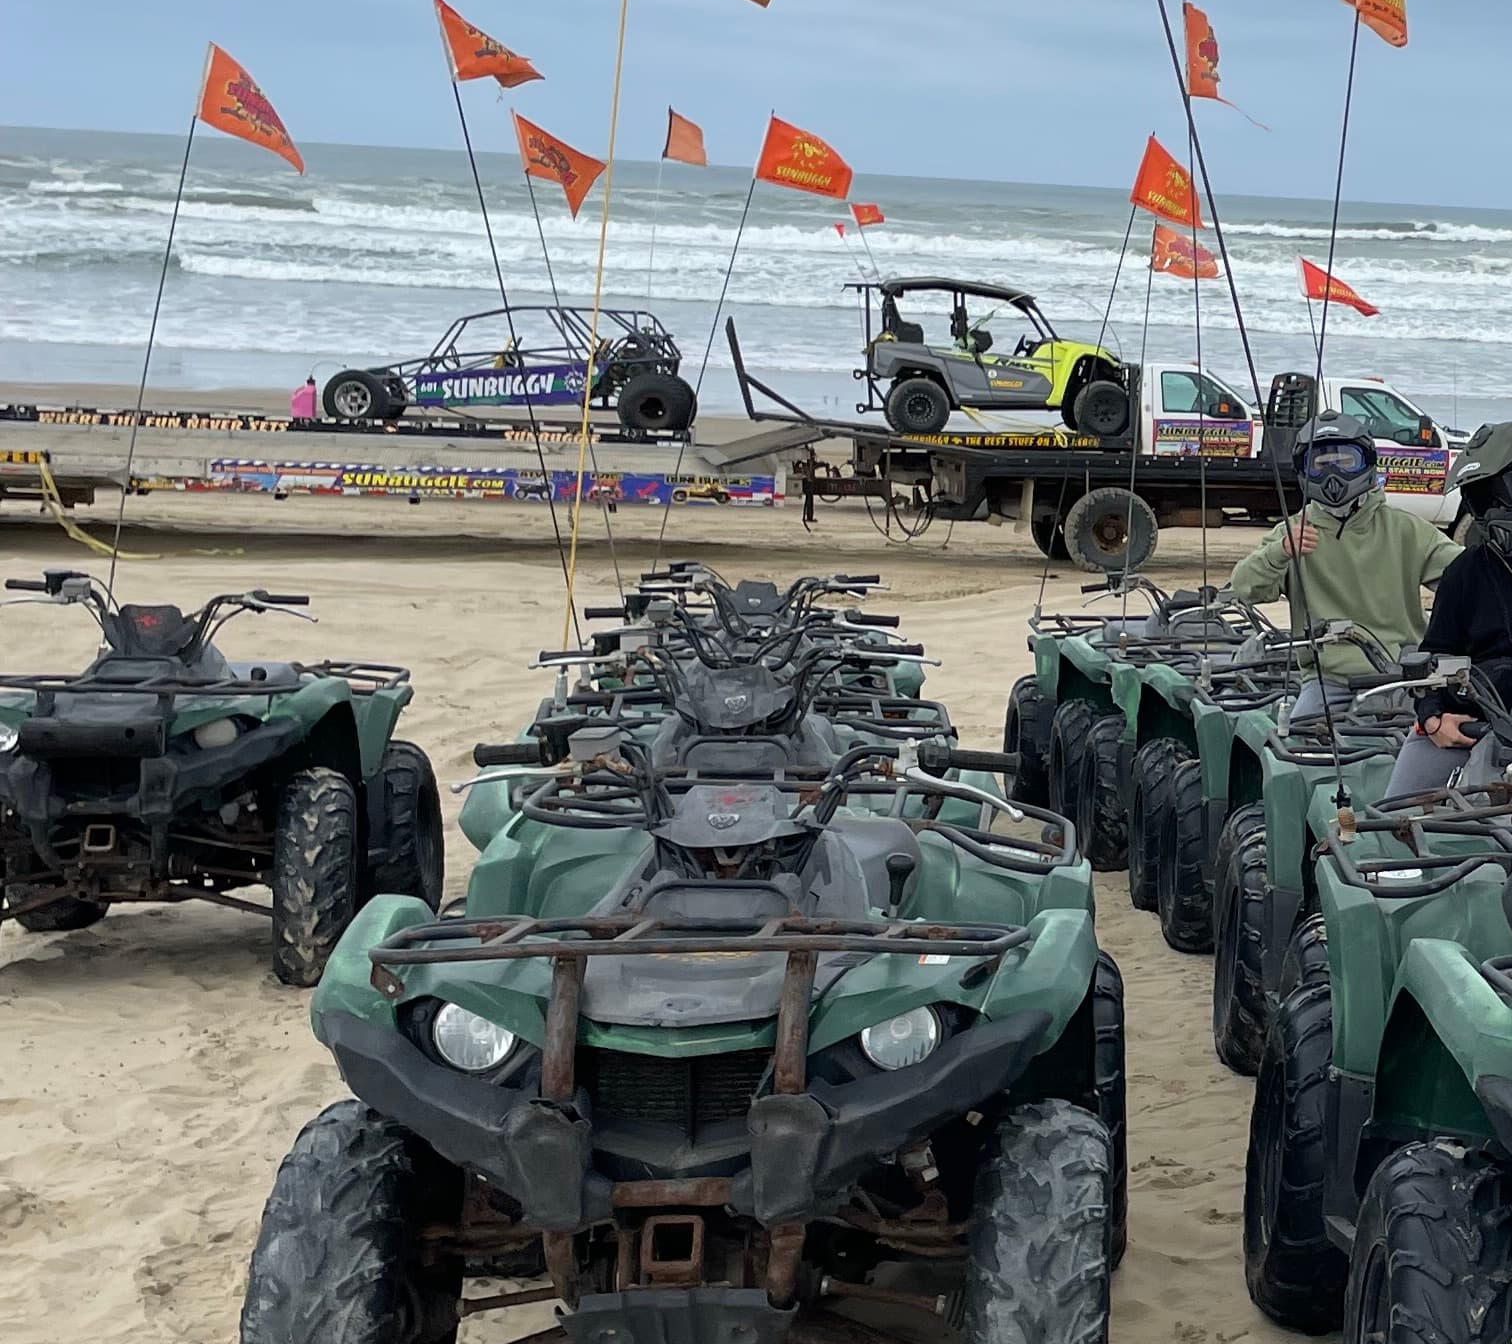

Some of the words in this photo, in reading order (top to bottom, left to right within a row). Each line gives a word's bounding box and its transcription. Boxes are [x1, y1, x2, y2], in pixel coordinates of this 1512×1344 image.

[441, 372, 556, 400] SUNBUGGY
[38, 411, 101, 425] WHERE
[145, 415, 181, 429] FUN
[186, 417, 243, 431] NEVER
[249, 420, 290, 433] SETS
[504, 429, 601, 444] SUNBUGGE
